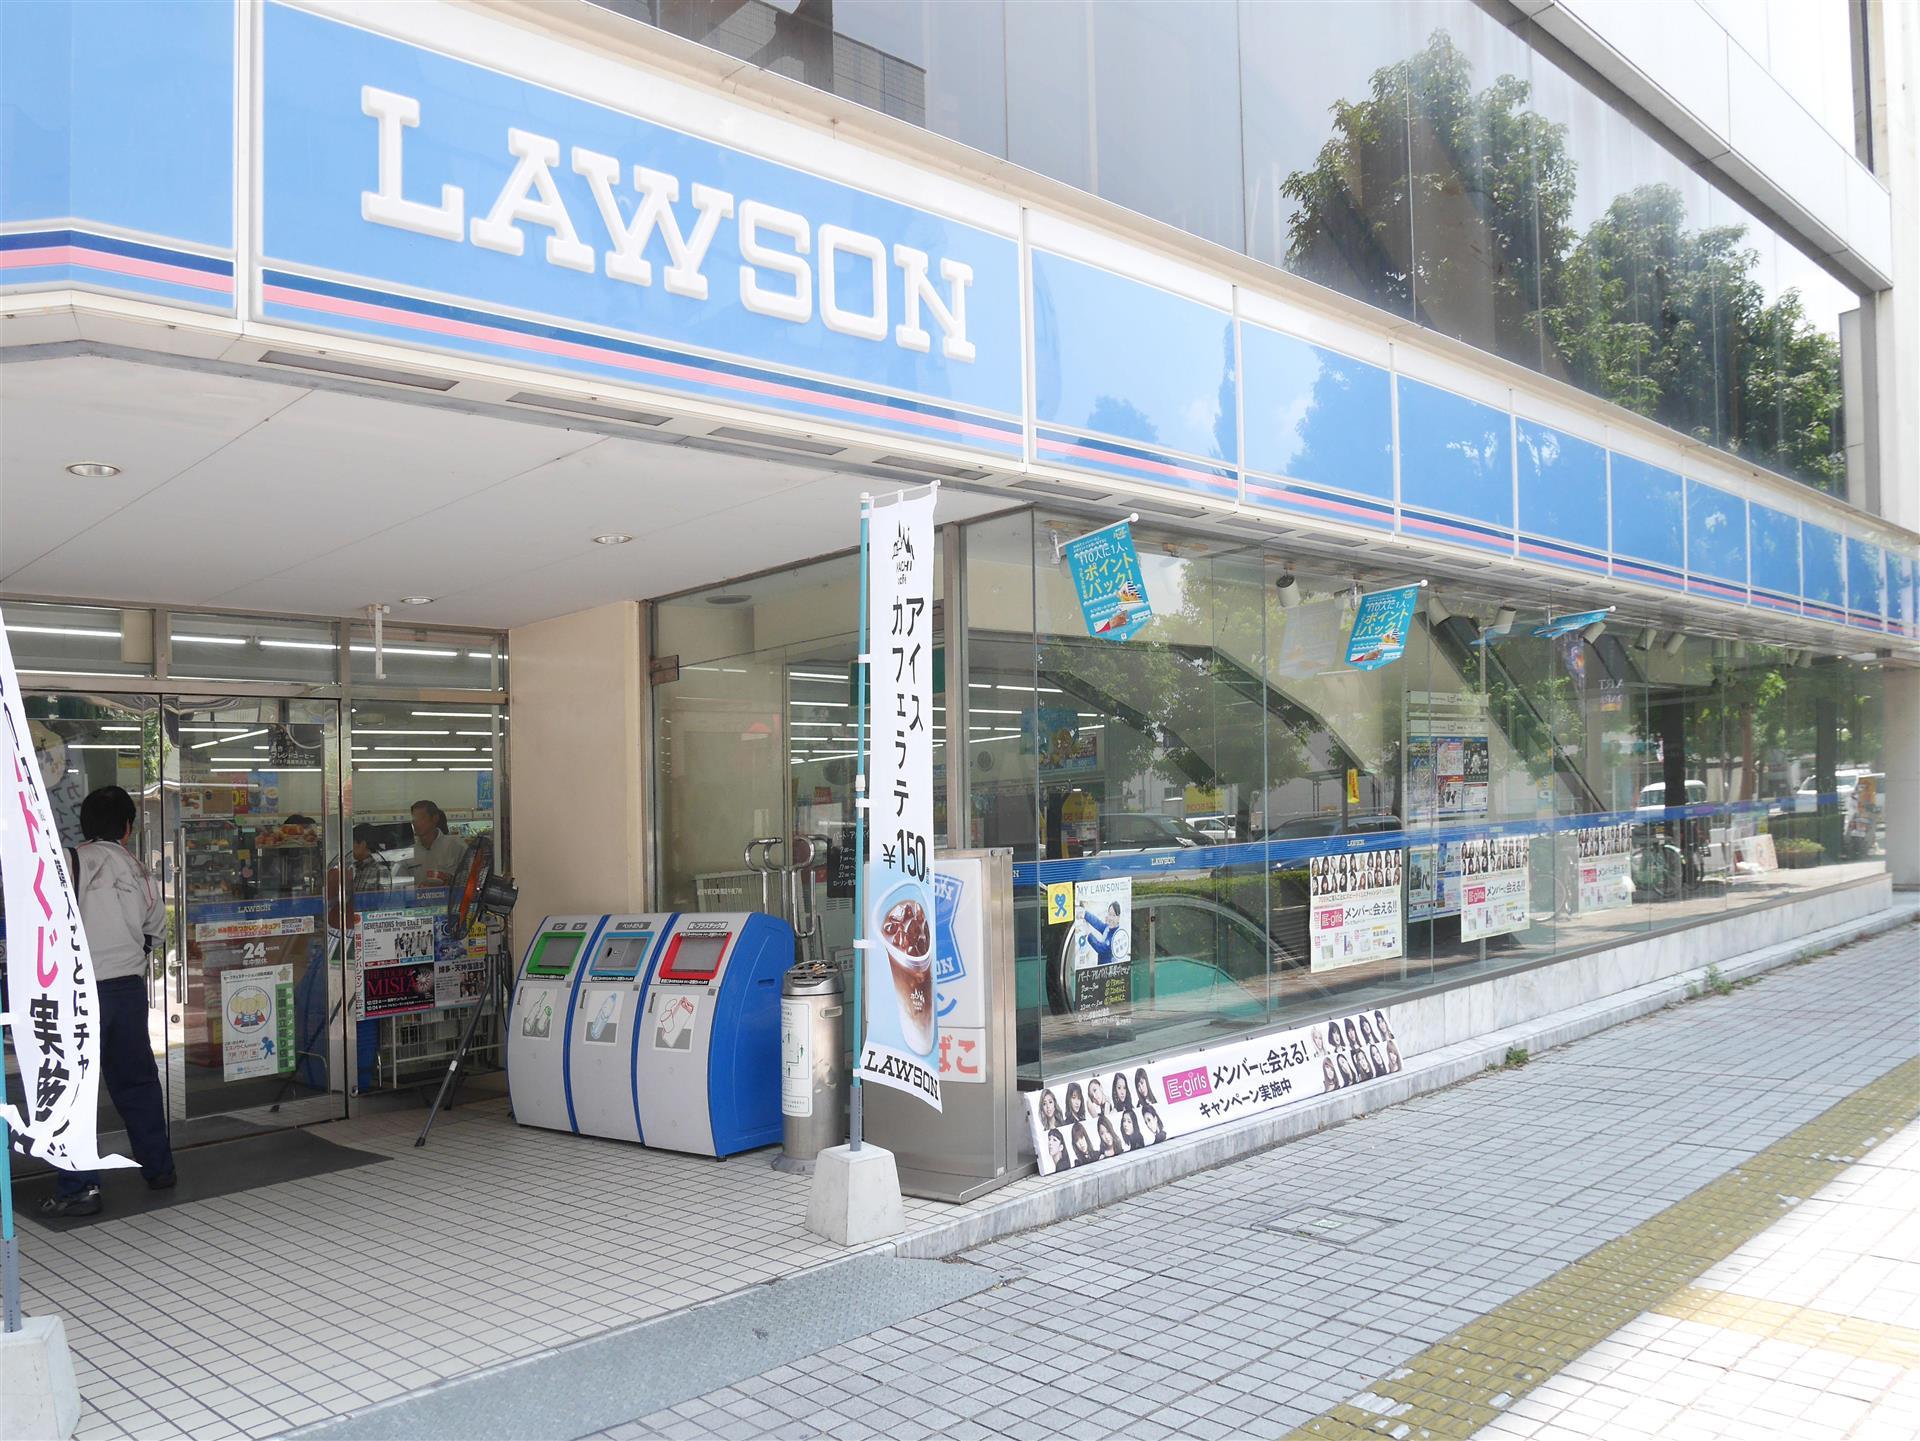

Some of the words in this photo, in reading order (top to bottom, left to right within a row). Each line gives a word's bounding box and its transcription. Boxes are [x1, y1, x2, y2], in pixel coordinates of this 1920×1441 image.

[361, 84, 976, 363] LAWSON
[1085, 552, 1134, 581] ポイント
[1364, 607, 1409, 624] ポイント
[906, 597, 925, 732] アイス
[891, 594, 909, 817] カフェラテ
[882, 828, 926, 883] ¥150
[1151, 856, 1176, 866] LAWSON
[1077, 885, 1089, 896] MY
[1090, 881, 1120, 894] LAWSON
[238, 903, 272, 914] LAWSON
[1321, 911, 1343, 927] E-girls
[364, 920, 395, 930] GENERATIONS
[243, 942, 266, 959] 24
[366, 974, 418, 996] MISIA
[864, 1050, 940, 1101] LAWSON
[1212, 1040, 1310, 1089] メンバーに会える!
[1166, 1071, 1208, 1100] E-girls
[1199, 1077, 1292, 1118] キャンペーン実施中
